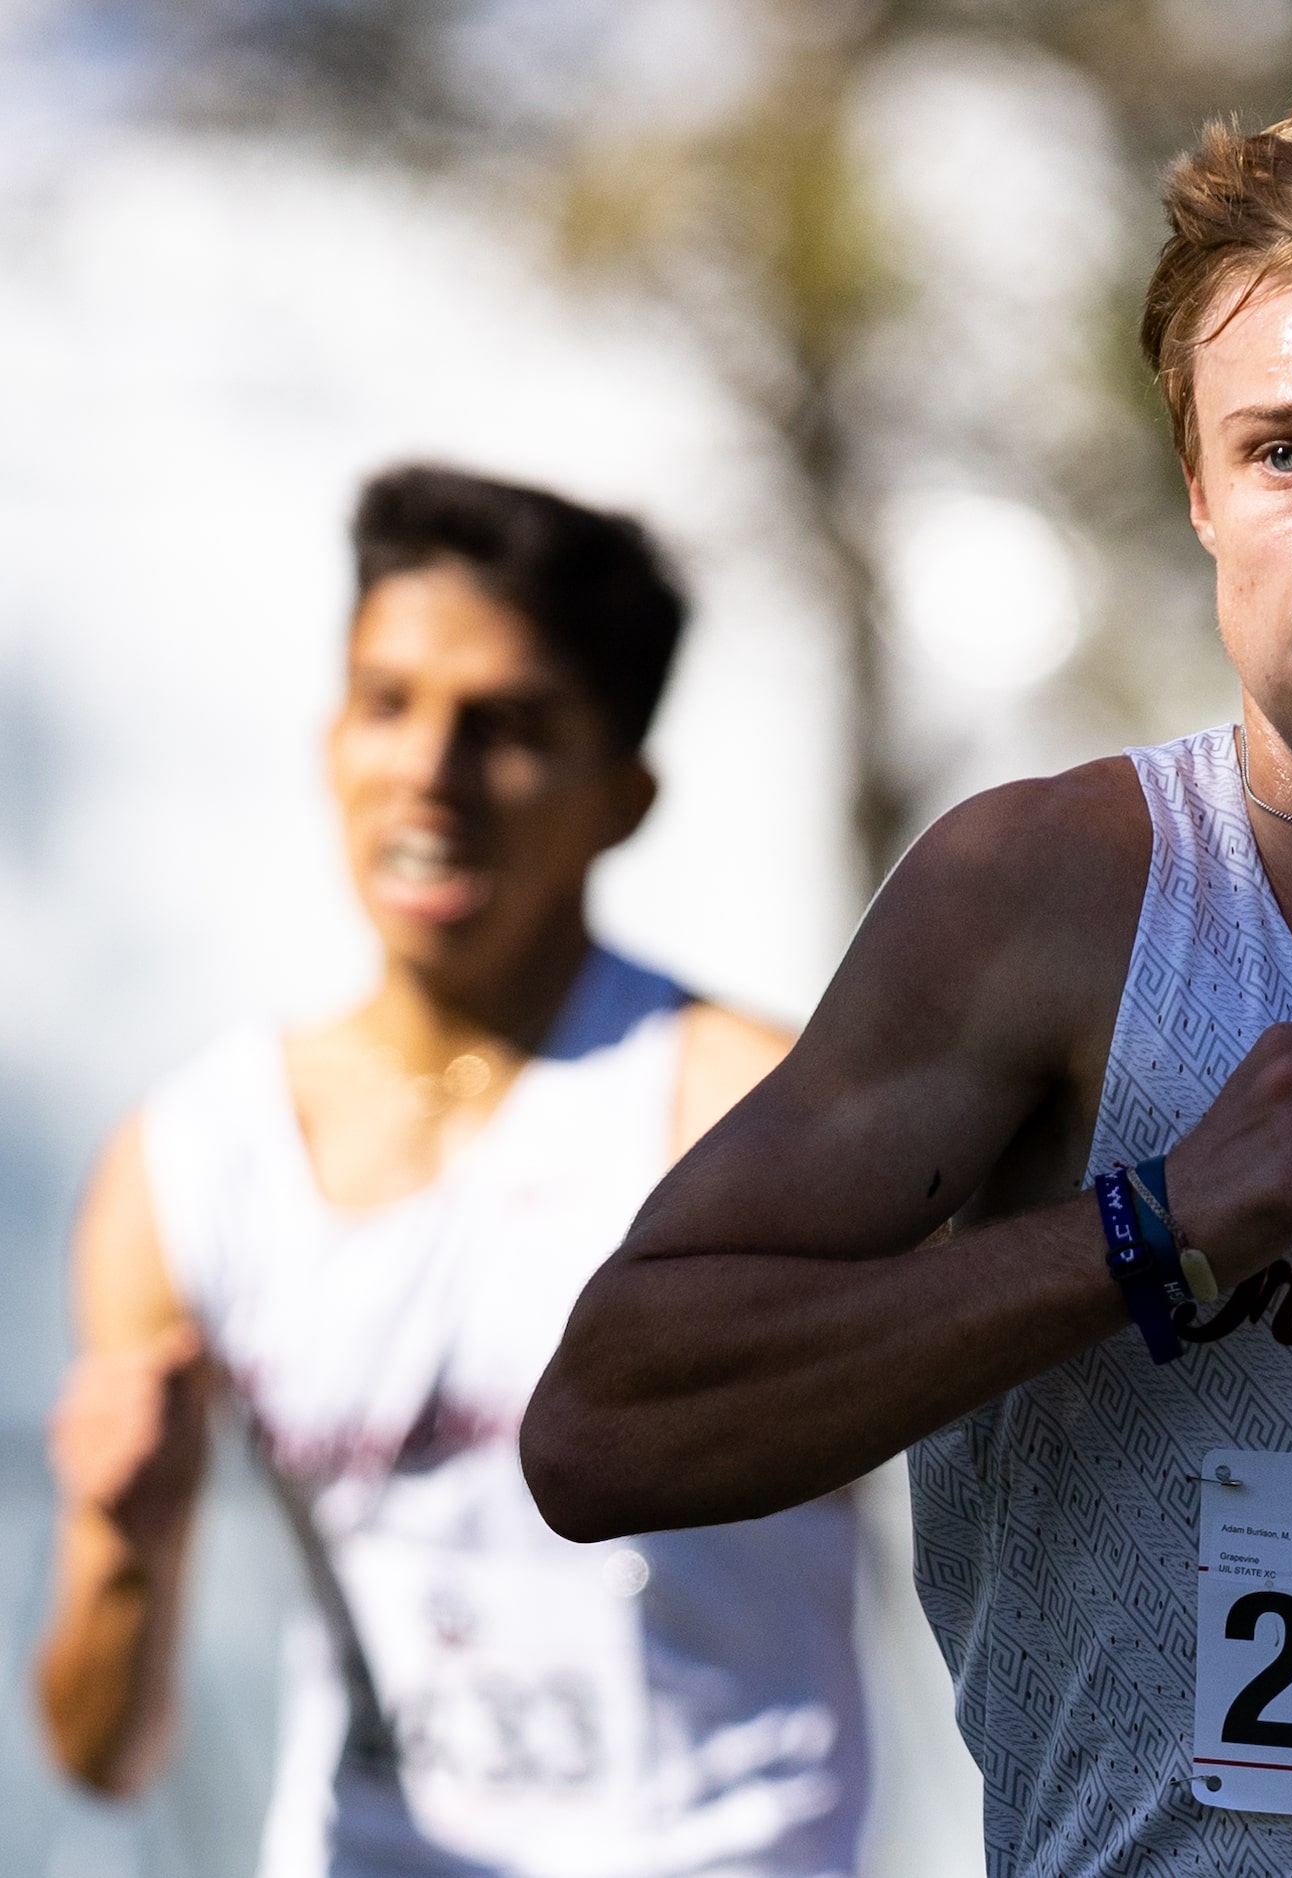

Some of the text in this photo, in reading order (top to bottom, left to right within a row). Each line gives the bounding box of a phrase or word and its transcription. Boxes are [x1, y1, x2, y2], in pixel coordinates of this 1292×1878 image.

[1221, 1524, 1245, 1534] Adam
[1219, 1552, 1260, 1565] Grapevine
[1218, 1564, 1277, 1579] UIL STATE XC
